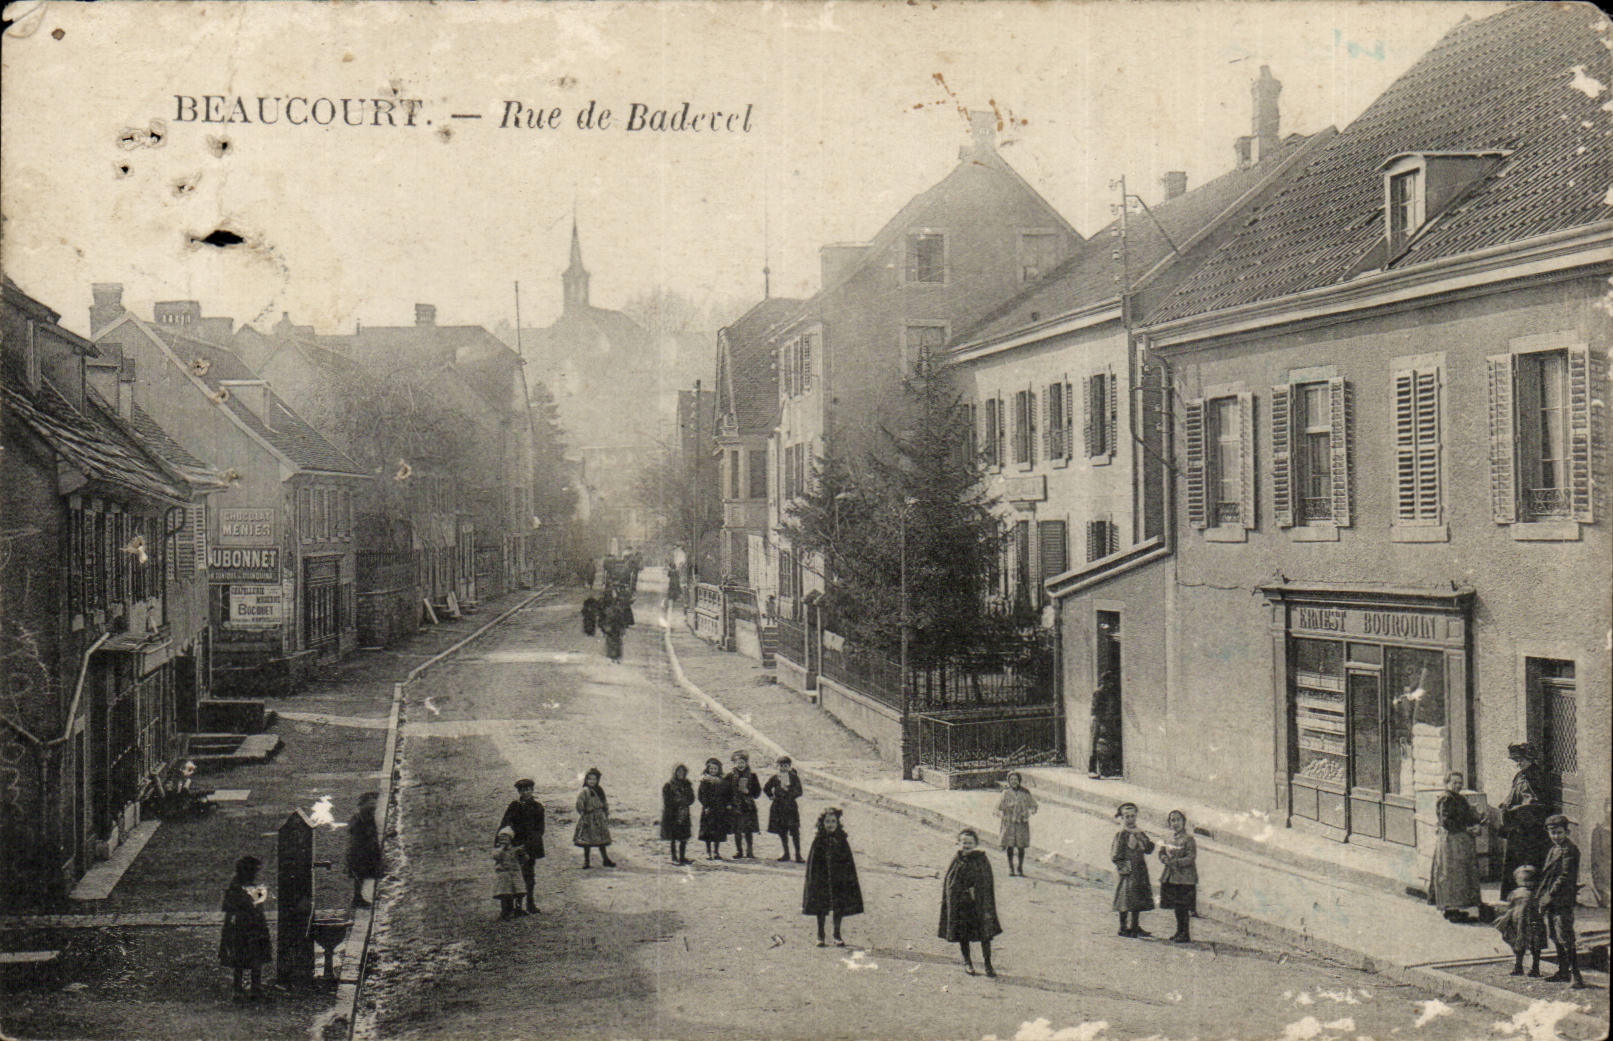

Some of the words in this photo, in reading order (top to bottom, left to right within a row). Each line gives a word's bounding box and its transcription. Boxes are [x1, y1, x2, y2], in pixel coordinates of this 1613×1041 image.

[222, 524, 272, 537] MENIER
[208, 549, 277, 568] UBONNET
[1299, 608, 1347, 633] ERNEST
[1363, 612, 1437, 641] BOURQUIN
